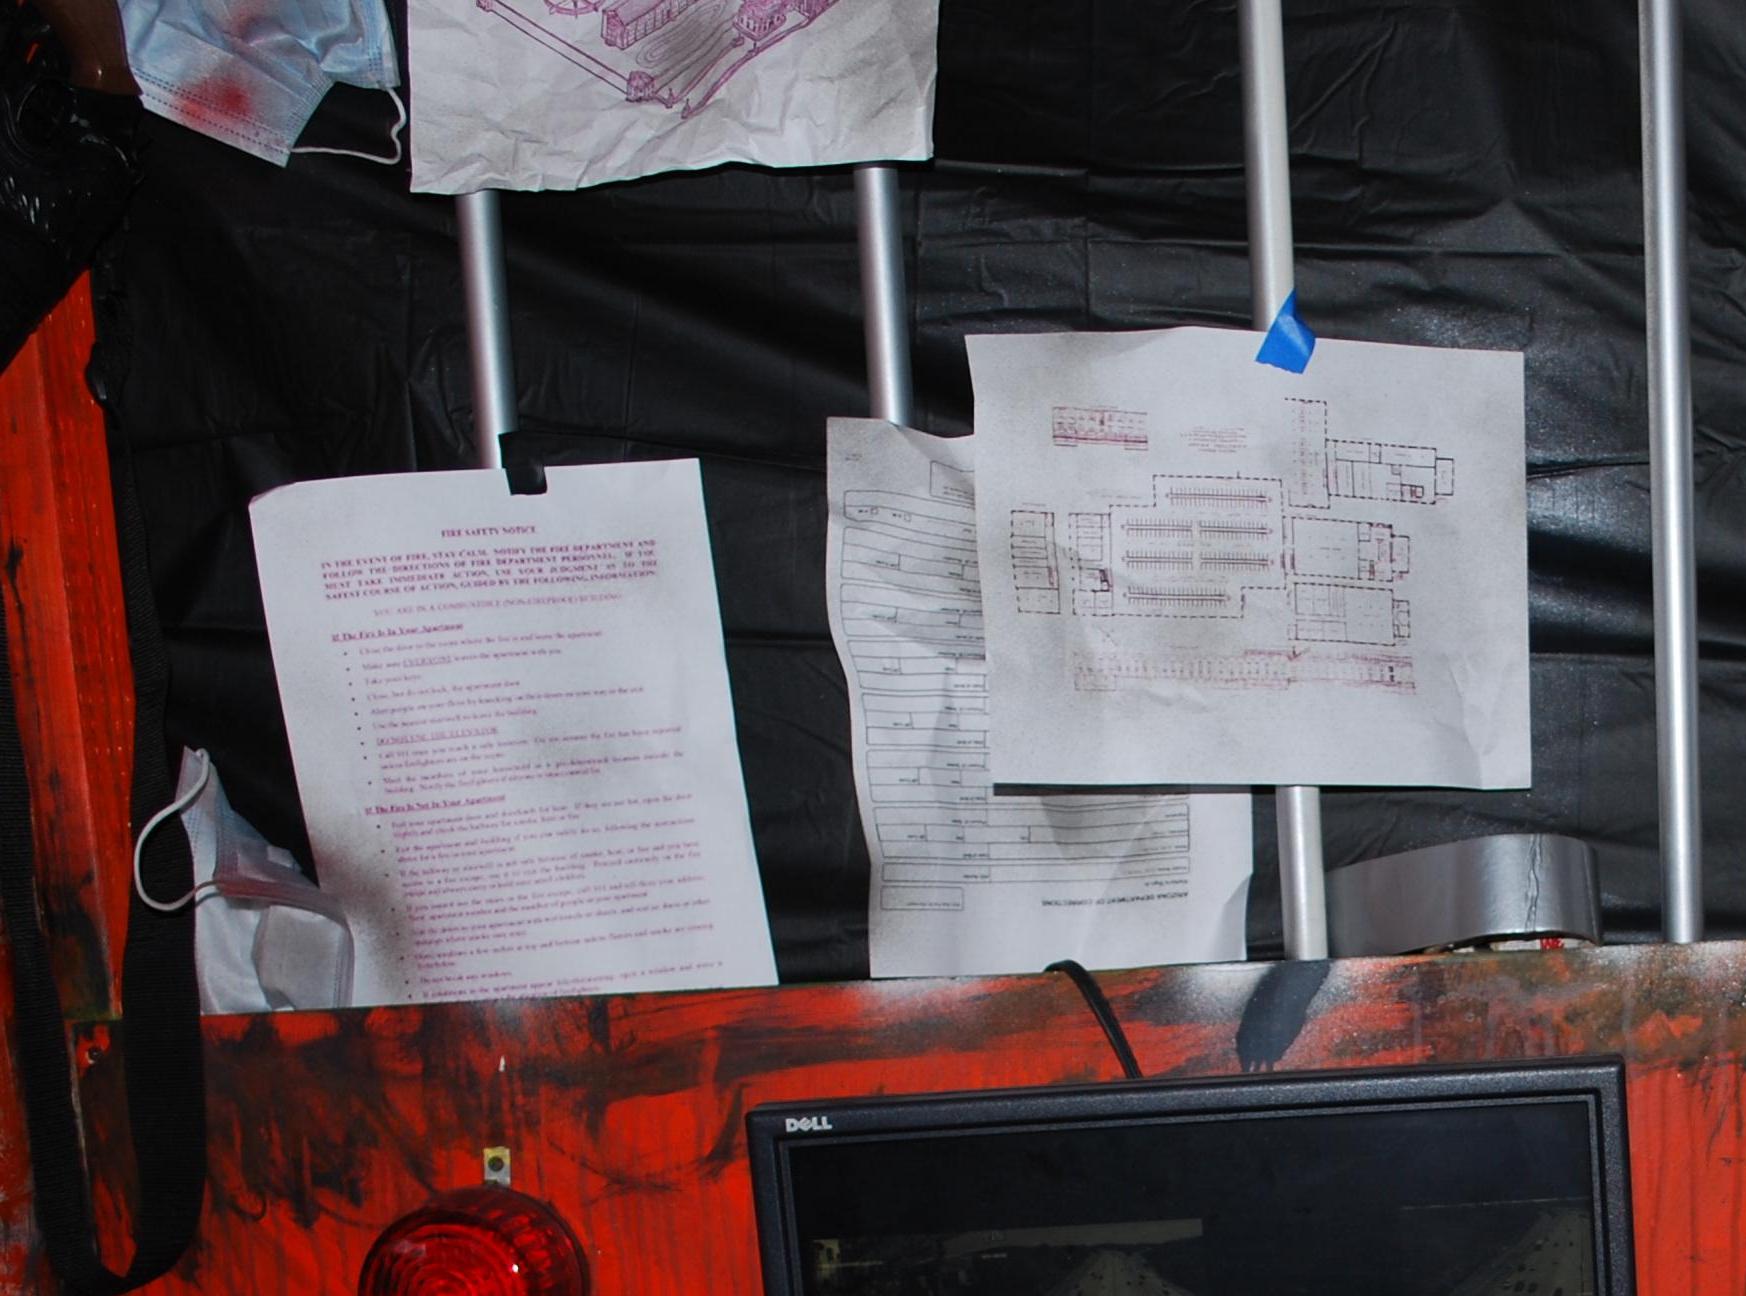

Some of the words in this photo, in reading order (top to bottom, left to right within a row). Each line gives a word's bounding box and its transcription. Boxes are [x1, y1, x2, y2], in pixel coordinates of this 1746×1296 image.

[441, 529, 462, 538] FIRE
[465, 527, 499, 537] SAFETY
[502, 525, 536, 535] NOTICE
[785, 1115, 833, 1133] DELL
